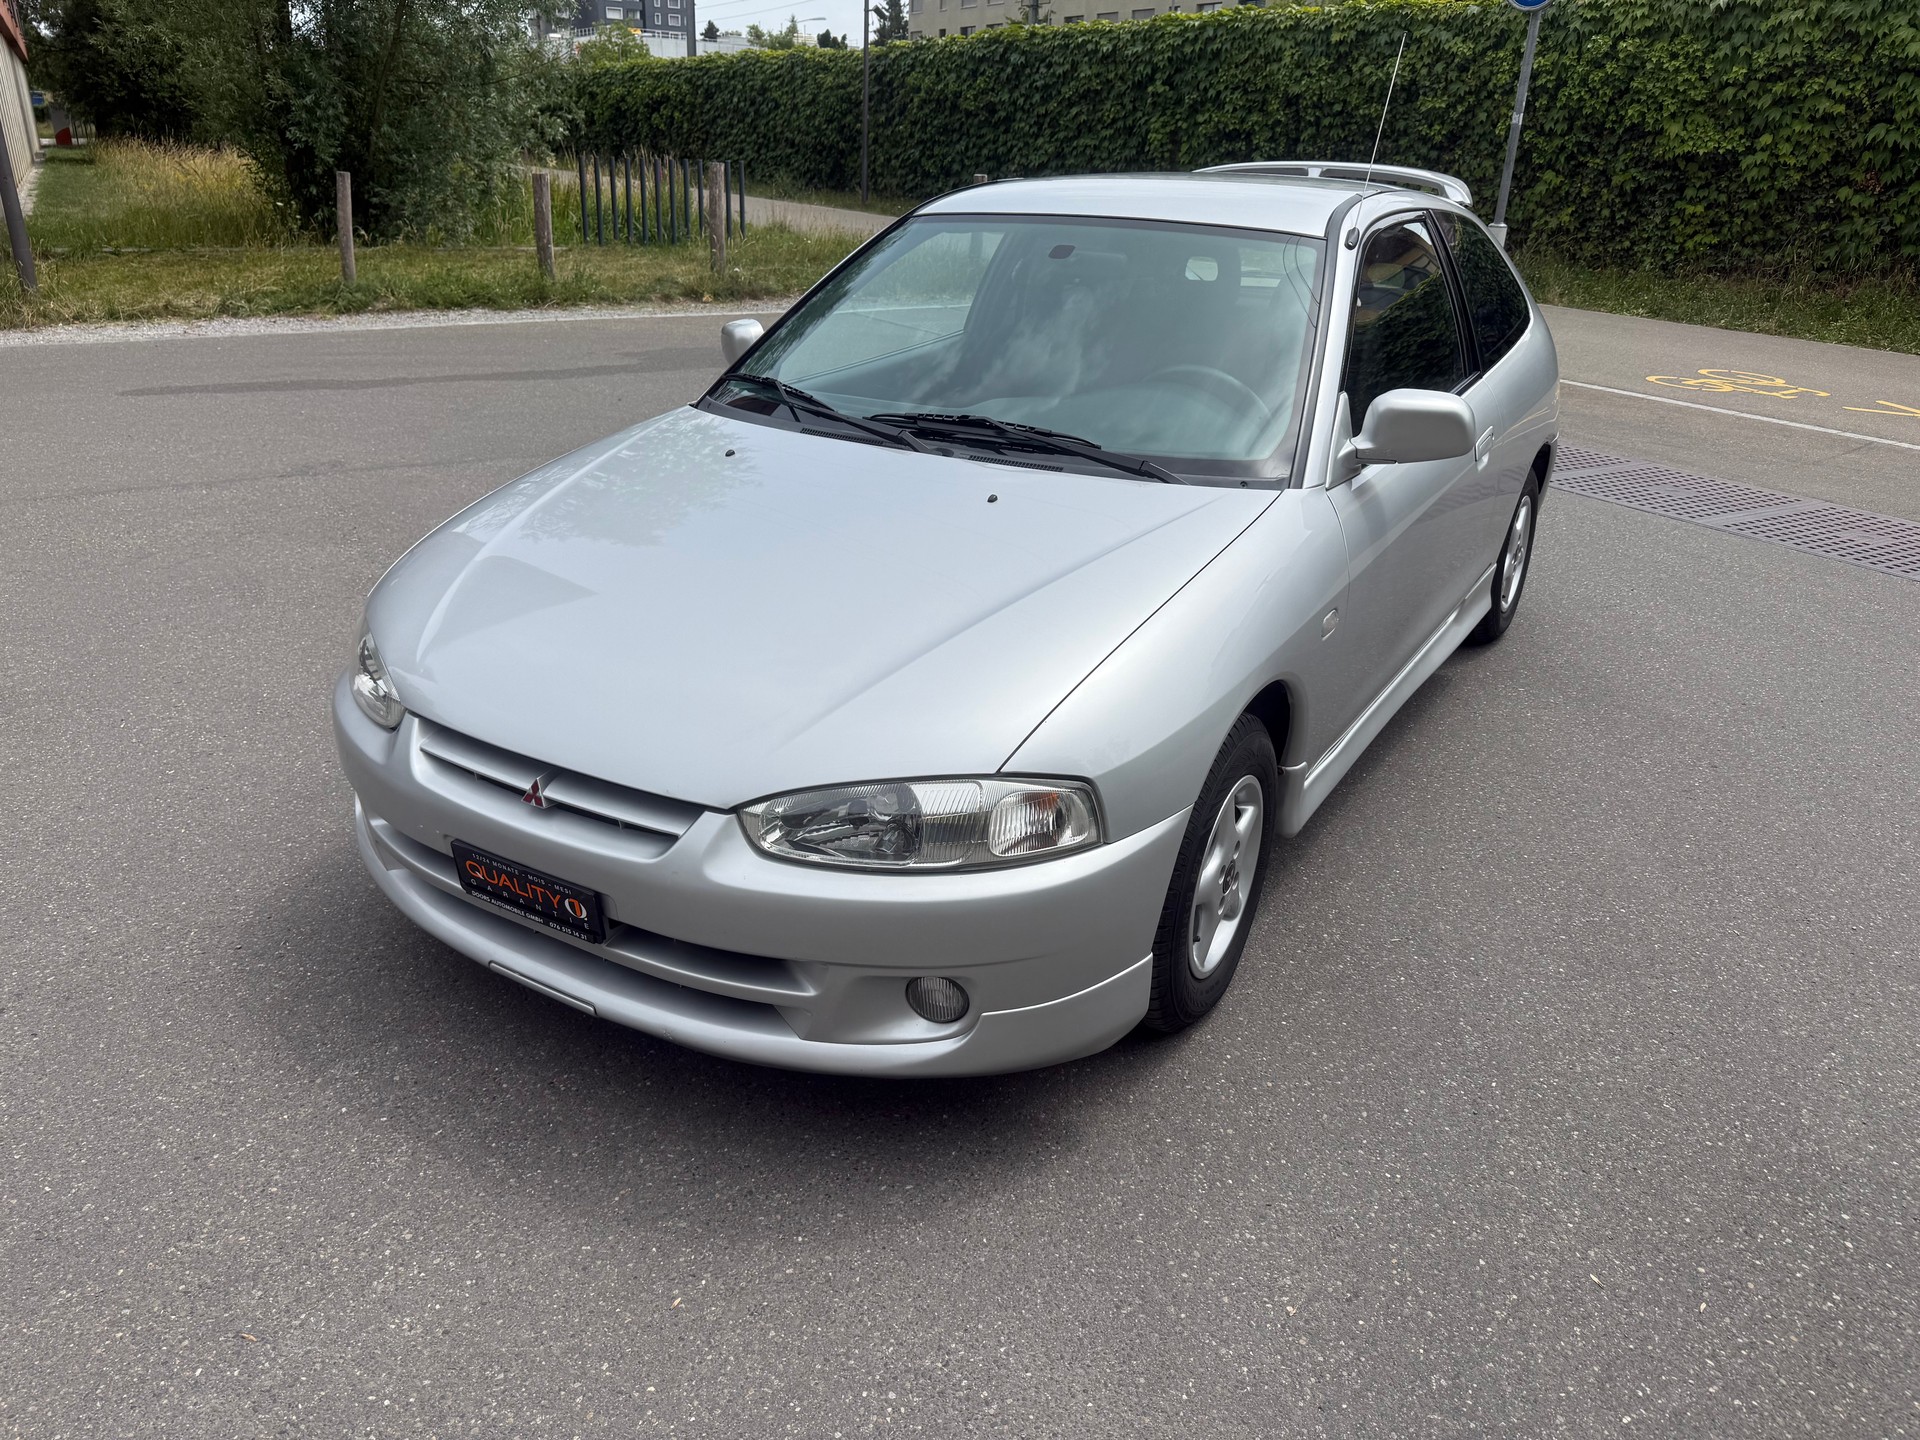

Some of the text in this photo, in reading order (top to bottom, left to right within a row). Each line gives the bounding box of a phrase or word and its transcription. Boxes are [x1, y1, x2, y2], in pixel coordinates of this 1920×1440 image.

[465, 860, 561, 909] QUALITY
[492, 861, 519, 875] MONATE
[527, 874, 545, 885] MOIS
[554, 884, 572, 895] MESI
[471, 890, 491, 902] DOORS
[491, 898, 526, 917] AUTOMOBILE
[549, 922, 561, 930] 076
